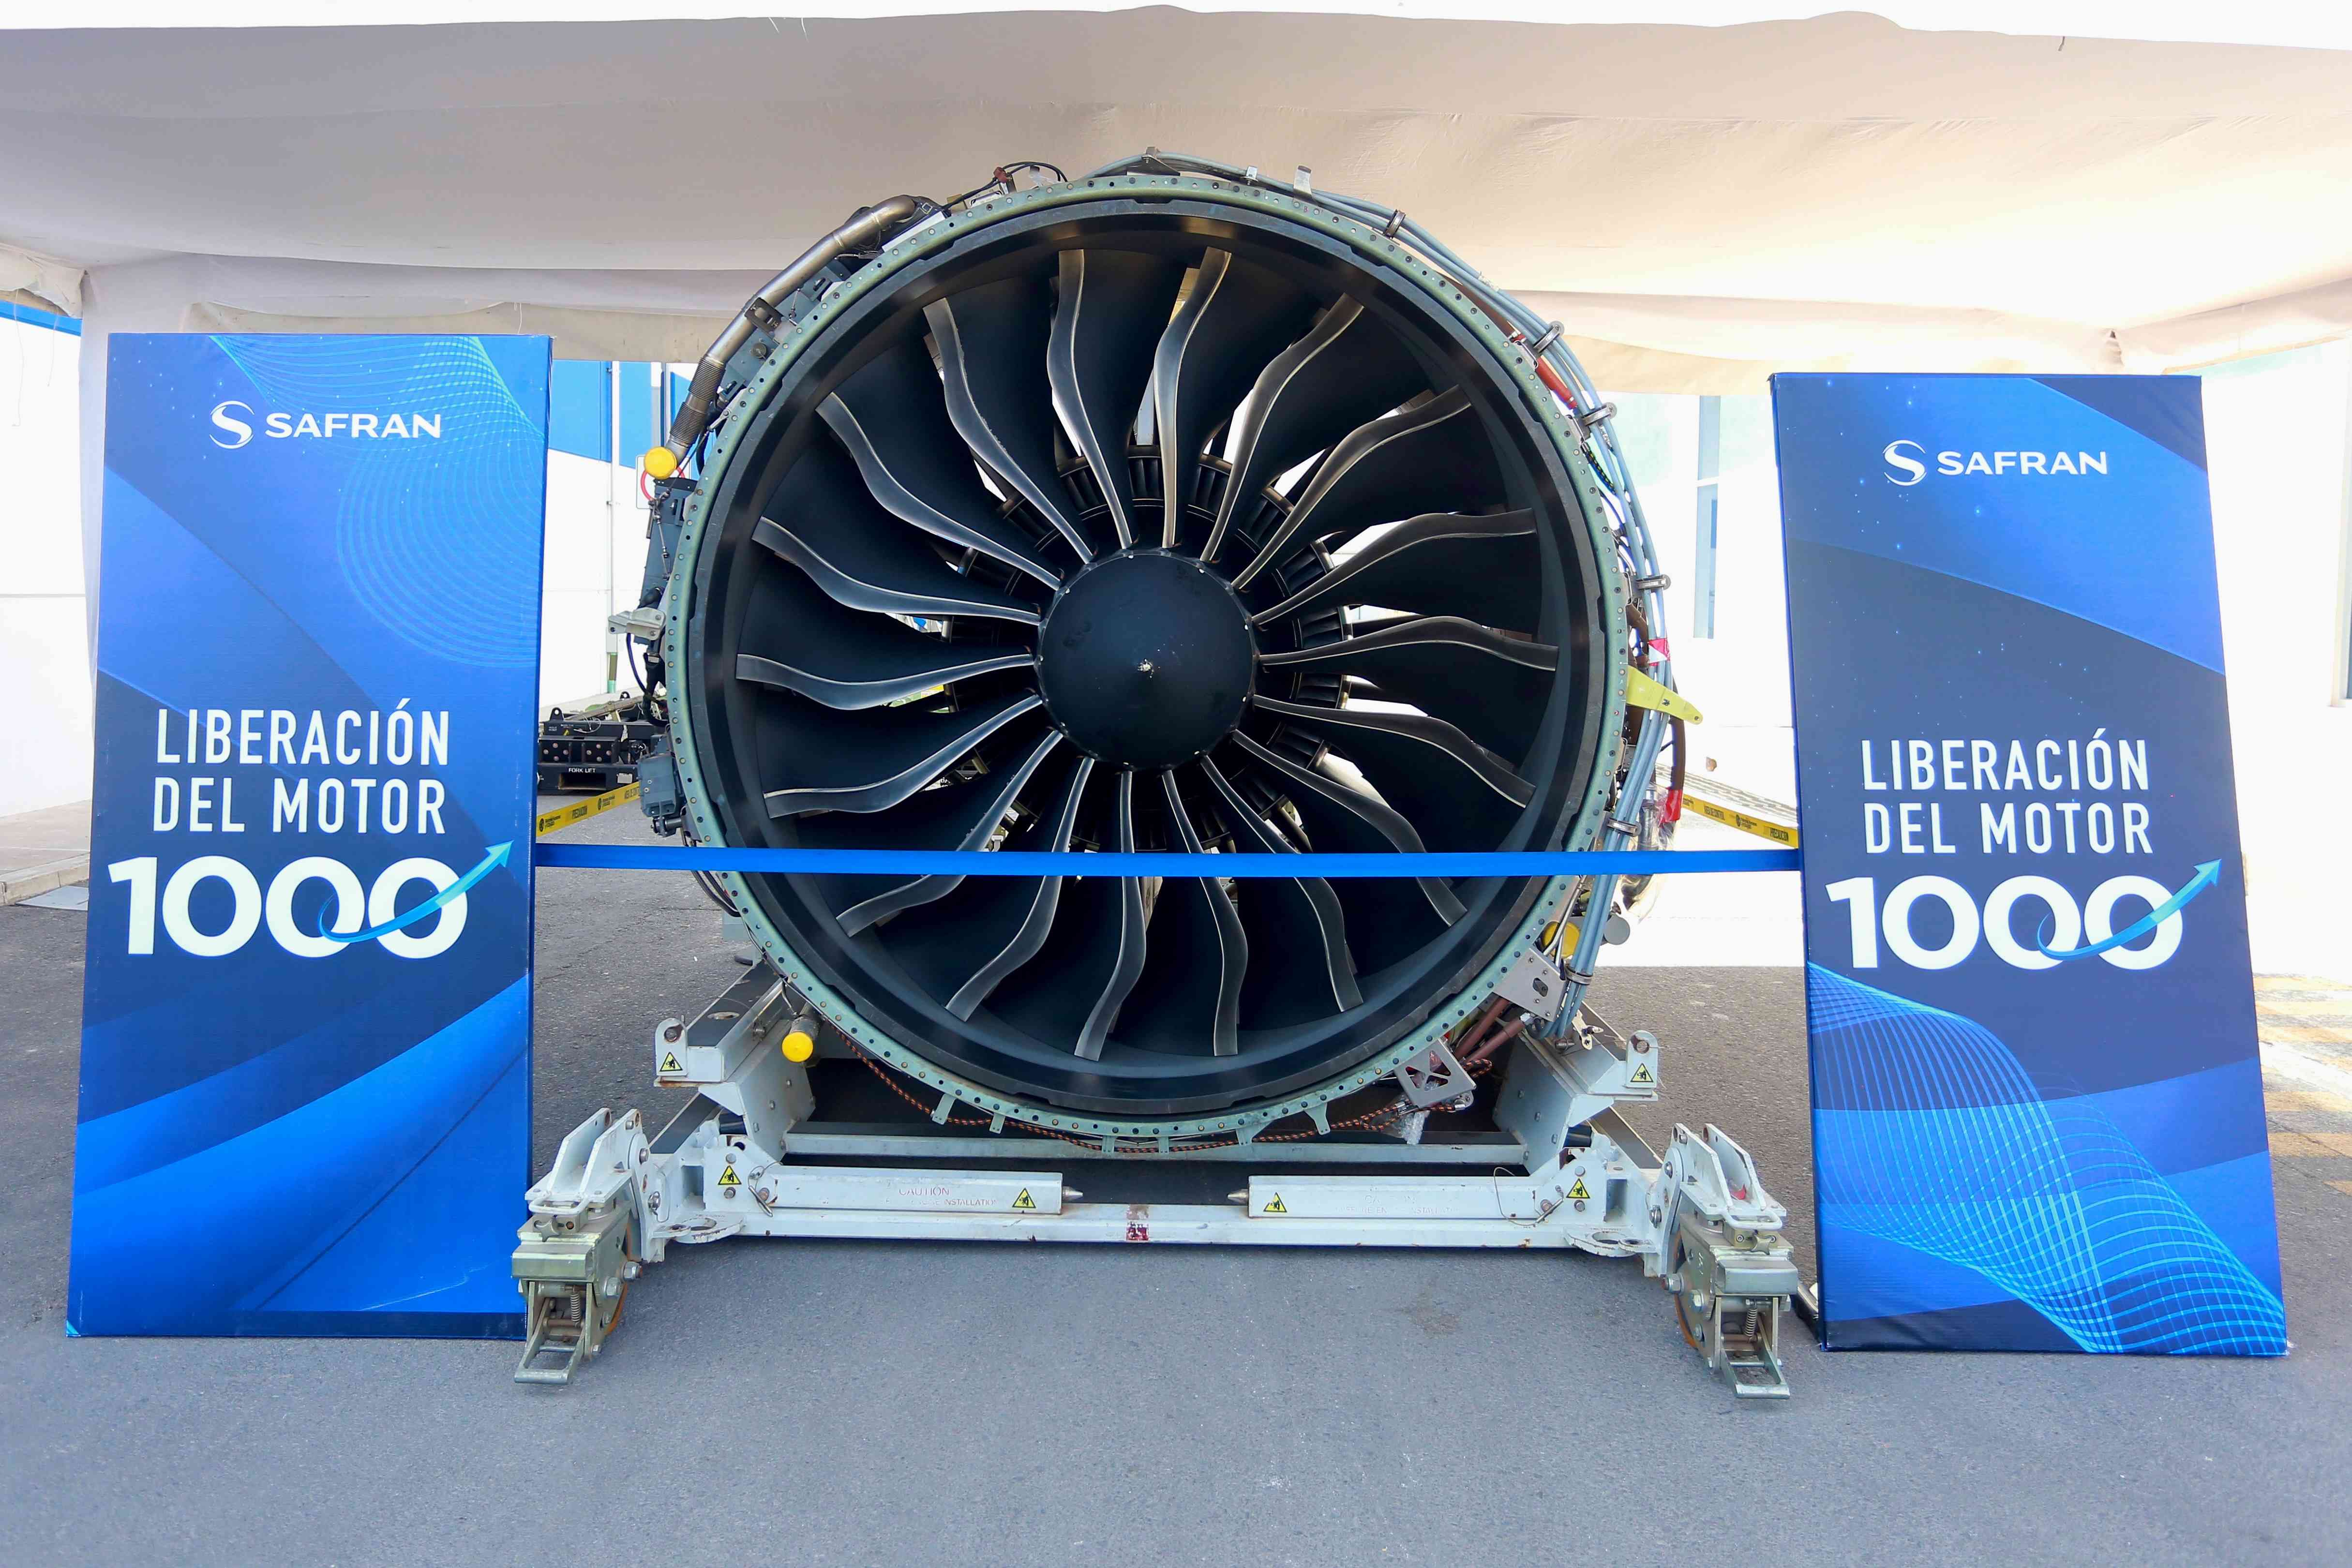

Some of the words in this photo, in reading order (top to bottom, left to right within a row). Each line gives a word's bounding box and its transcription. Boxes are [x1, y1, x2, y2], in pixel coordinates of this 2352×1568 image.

[265, 412, 442, 438] SAFRAN
[1937, 450, 2108, 476] SAFRAN
[157, 698, 449, 765] LIBERACIÓN
[1861, 728, 2149, 791] LIBERACIÓN
[153, 777, 245, 832] DEL
[273, 778, 445, 834] MOTOR
[1864, 802, 1956, 854] DEL
[1980, 802, 2153, 854] MOTOR
[107, 855, 468, 958] 1000
[1825, 875, 2183, 970] 1000
